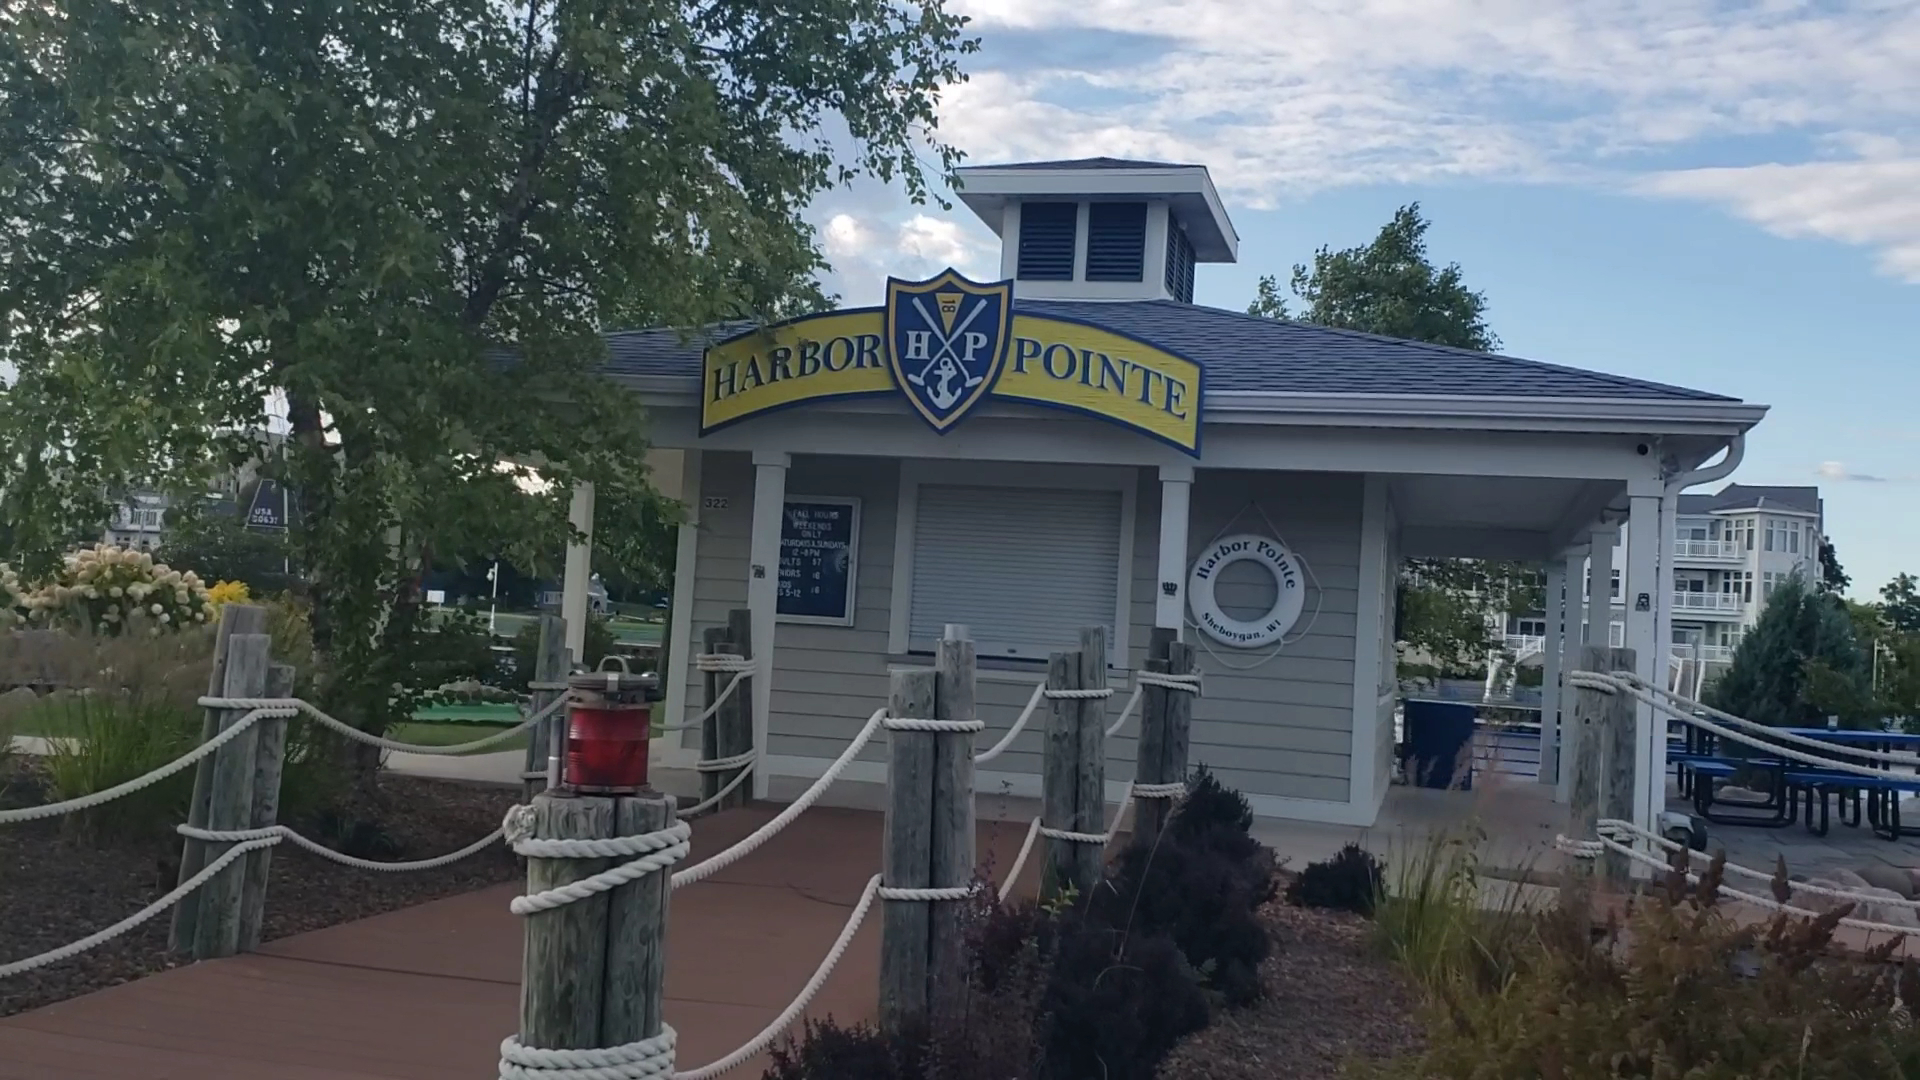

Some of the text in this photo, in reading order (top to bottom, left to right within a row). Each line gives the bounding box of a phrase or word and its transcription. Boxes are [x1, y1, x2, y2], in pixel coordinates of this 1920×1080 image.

[904, 330, 988, 361] H P
[711, 333, 1188, 421] HARBOR POINTE
[254, 507, 272, 516] USA
[704, 498, 728, 509] 322
[780, 538, 811, 548] ATURDAYS
[801, 530, 822, 539] ONLY
[1196, 540, 1296, 589] Harbor Pointe
[1201, 612, 1282, 642] Sheboygan, WI
